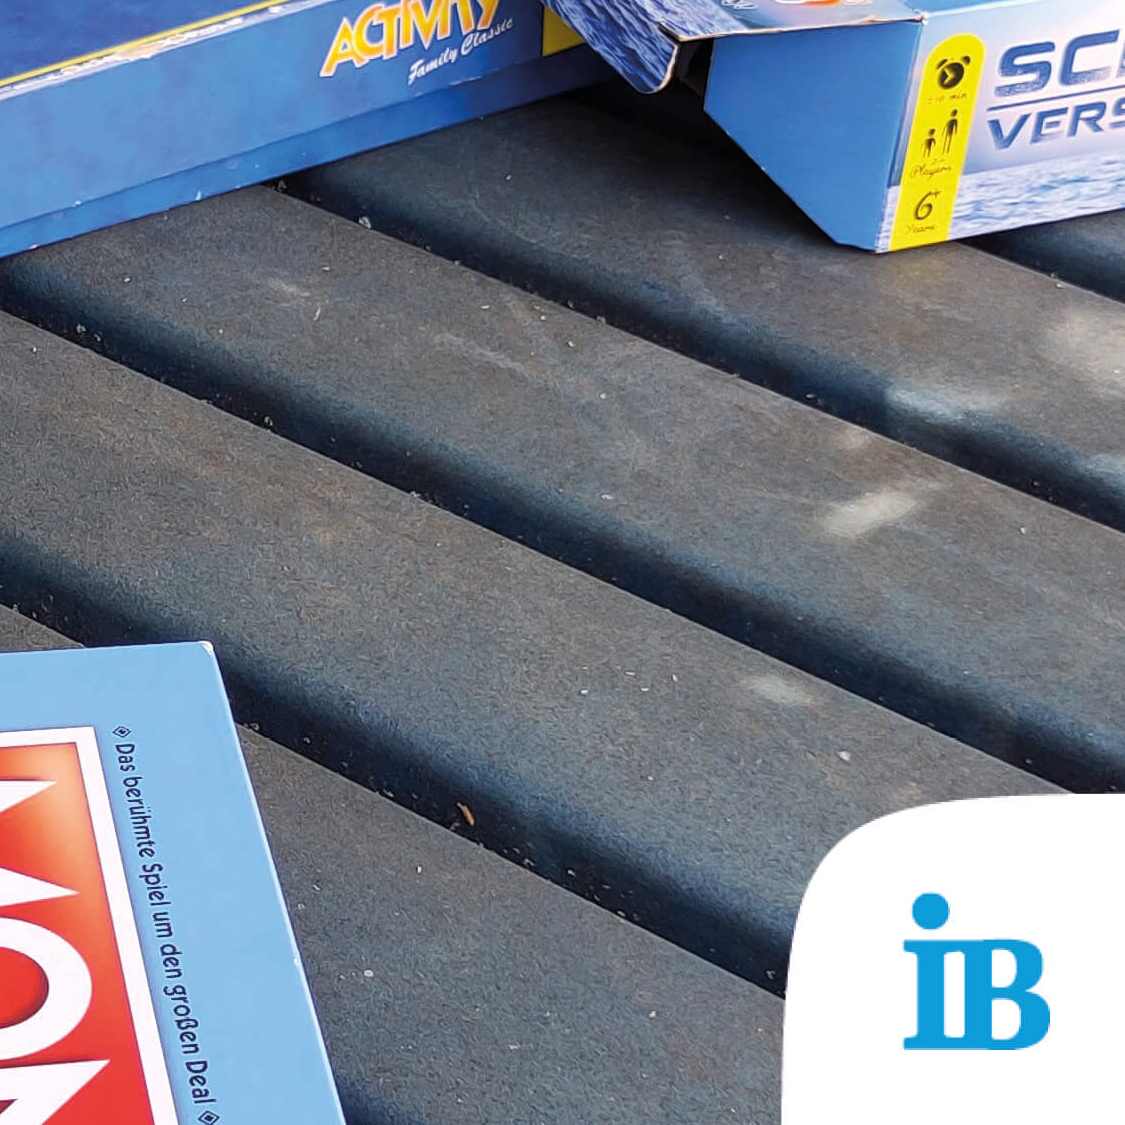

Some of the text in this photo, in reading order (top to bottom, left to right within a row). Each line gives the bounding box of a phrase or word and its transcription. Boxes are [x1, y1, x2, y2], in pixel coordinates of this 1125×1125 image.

[407, 18, 514, 85] Family Classic
[994, 28, 1125, 97] SC
[115, 743, 218, 1104] Das berühmte Spiel um den großen Deal
